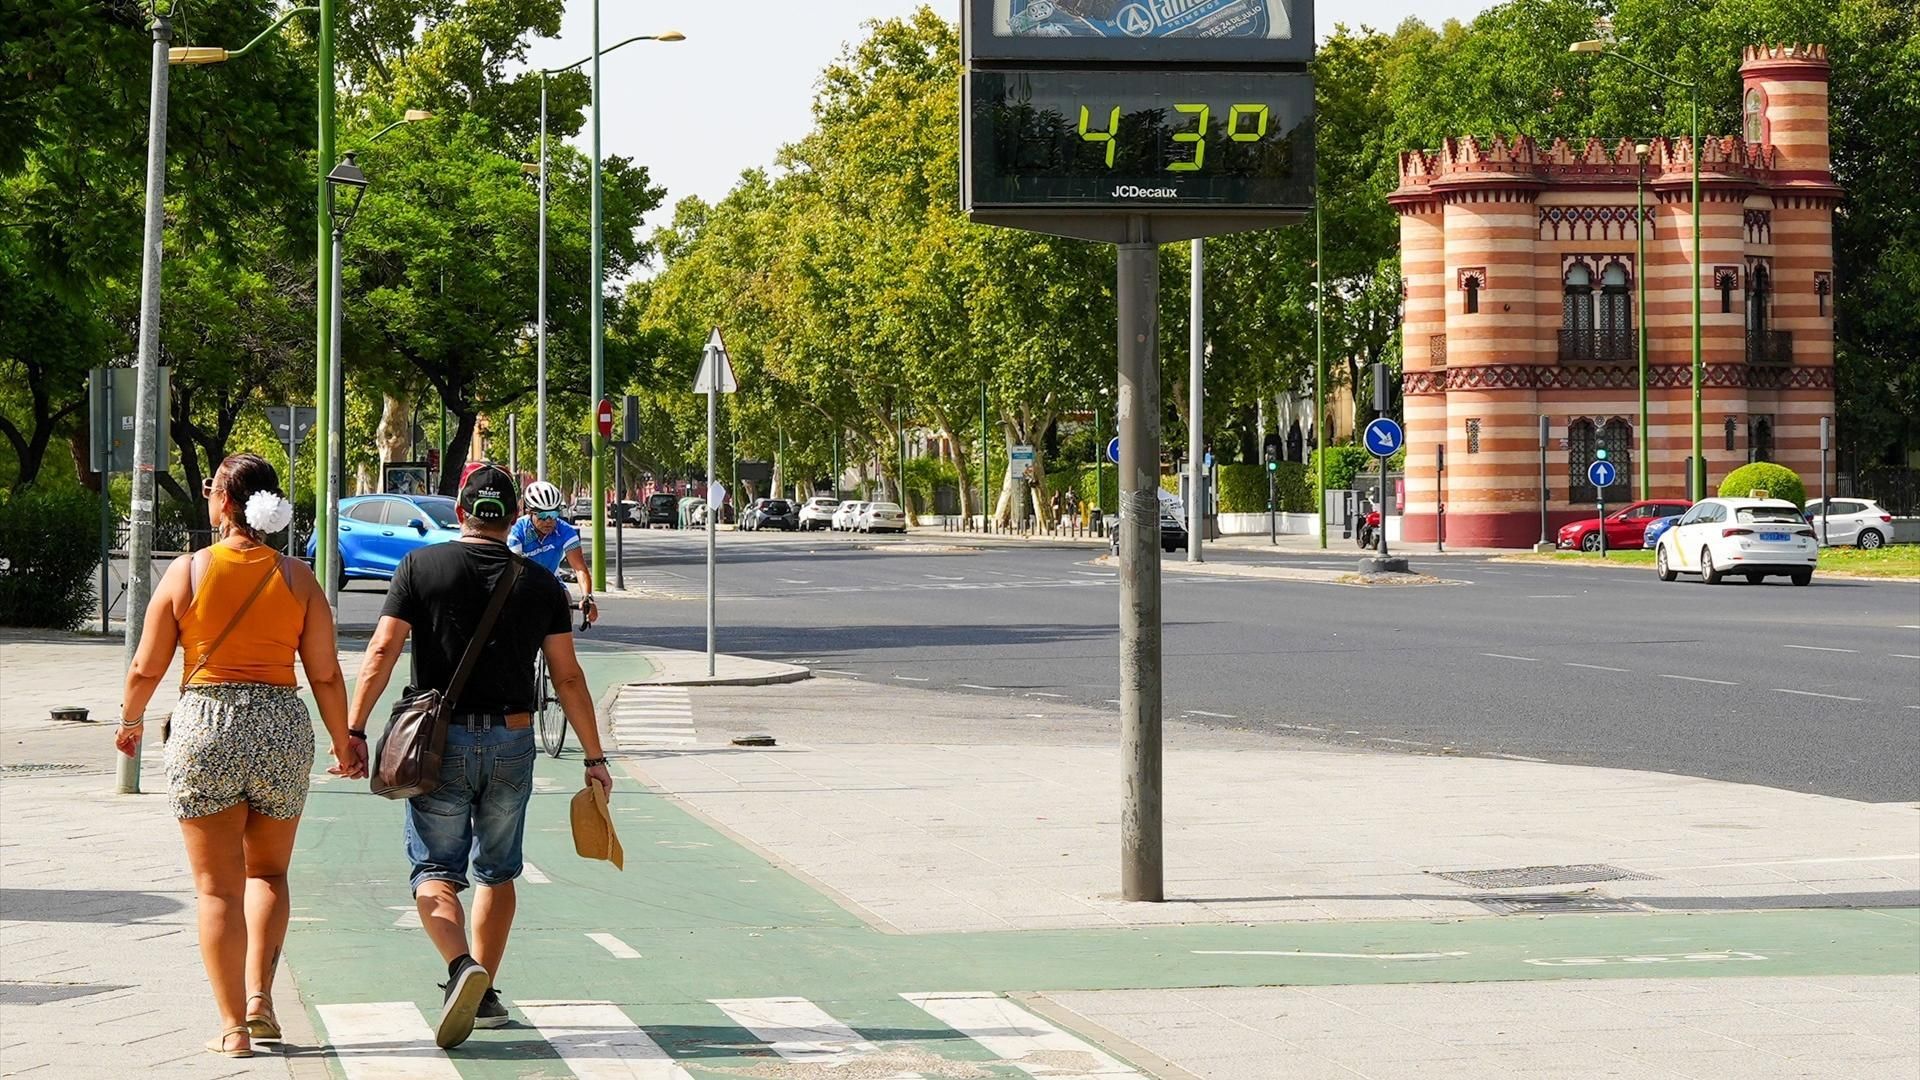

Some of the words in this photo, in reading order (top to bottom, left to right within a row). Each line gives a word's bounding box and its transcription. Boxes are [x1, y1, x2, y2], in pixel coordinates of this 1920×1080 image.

[1126, 7, 1149, 32] 4
[1220, 20, 1231, 30] 24
[1230, 16, 1242, 25] DE
[1241, 5, 1262, 20] JULIO
[1111, 185, 1177, 199] JCDecaux
